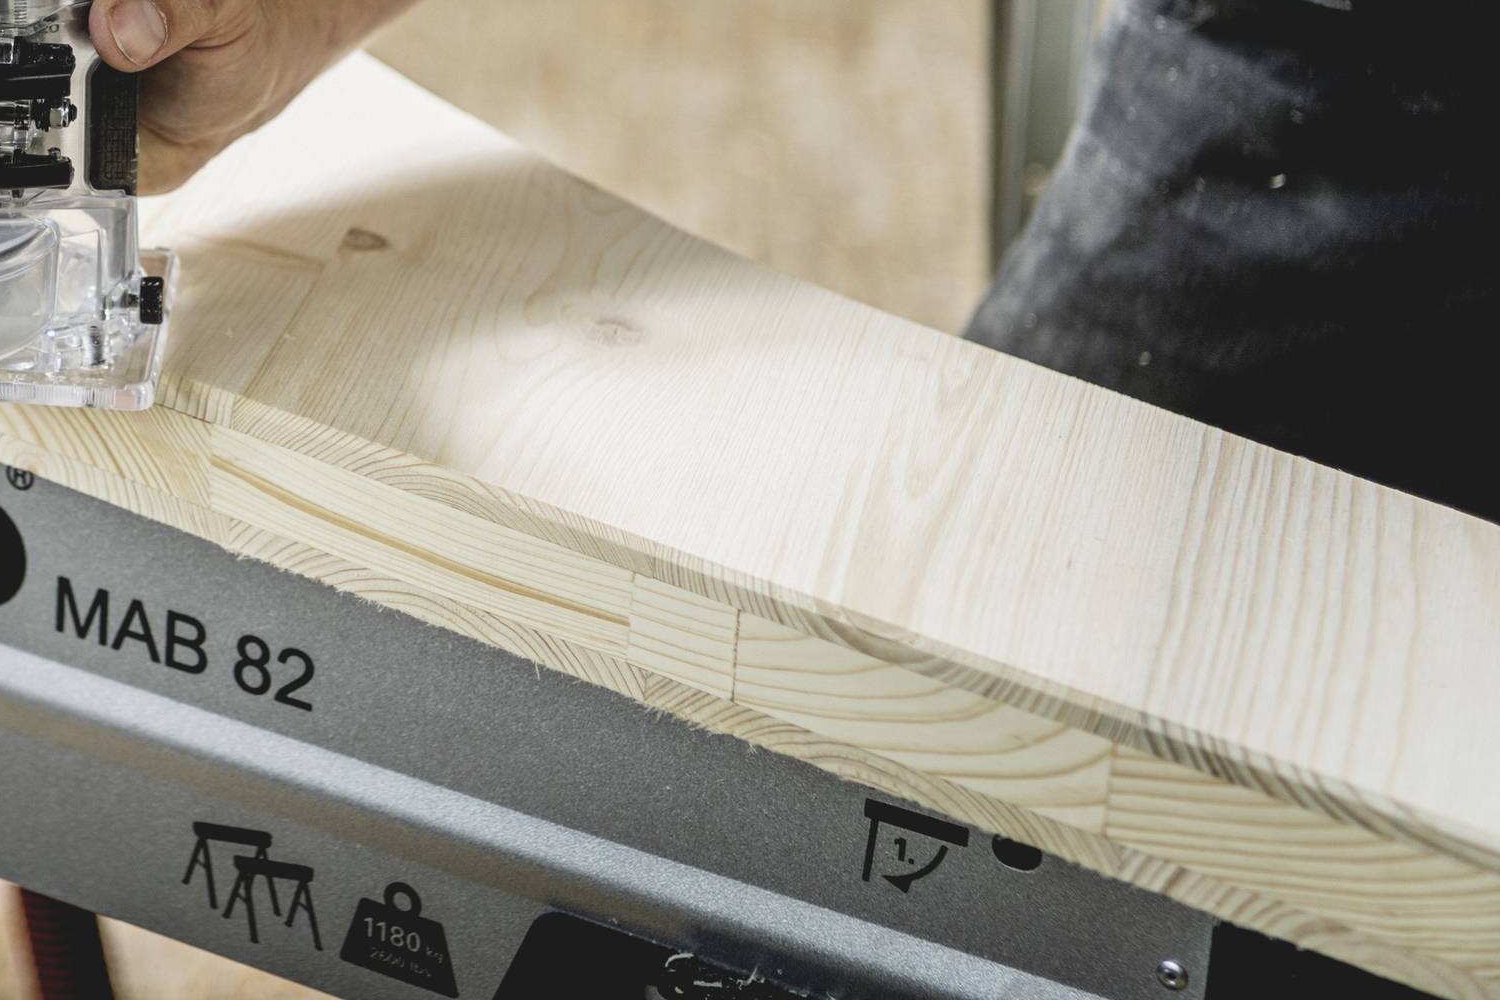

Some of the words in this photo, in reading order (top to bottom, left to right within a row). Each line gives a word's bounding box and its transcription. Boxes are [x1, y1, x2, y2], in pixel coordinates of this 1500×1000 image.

[54, 576, 210, 676] MAB
[232, 633, 316, 712] 82
[364, 917, 421, 952] 1180
